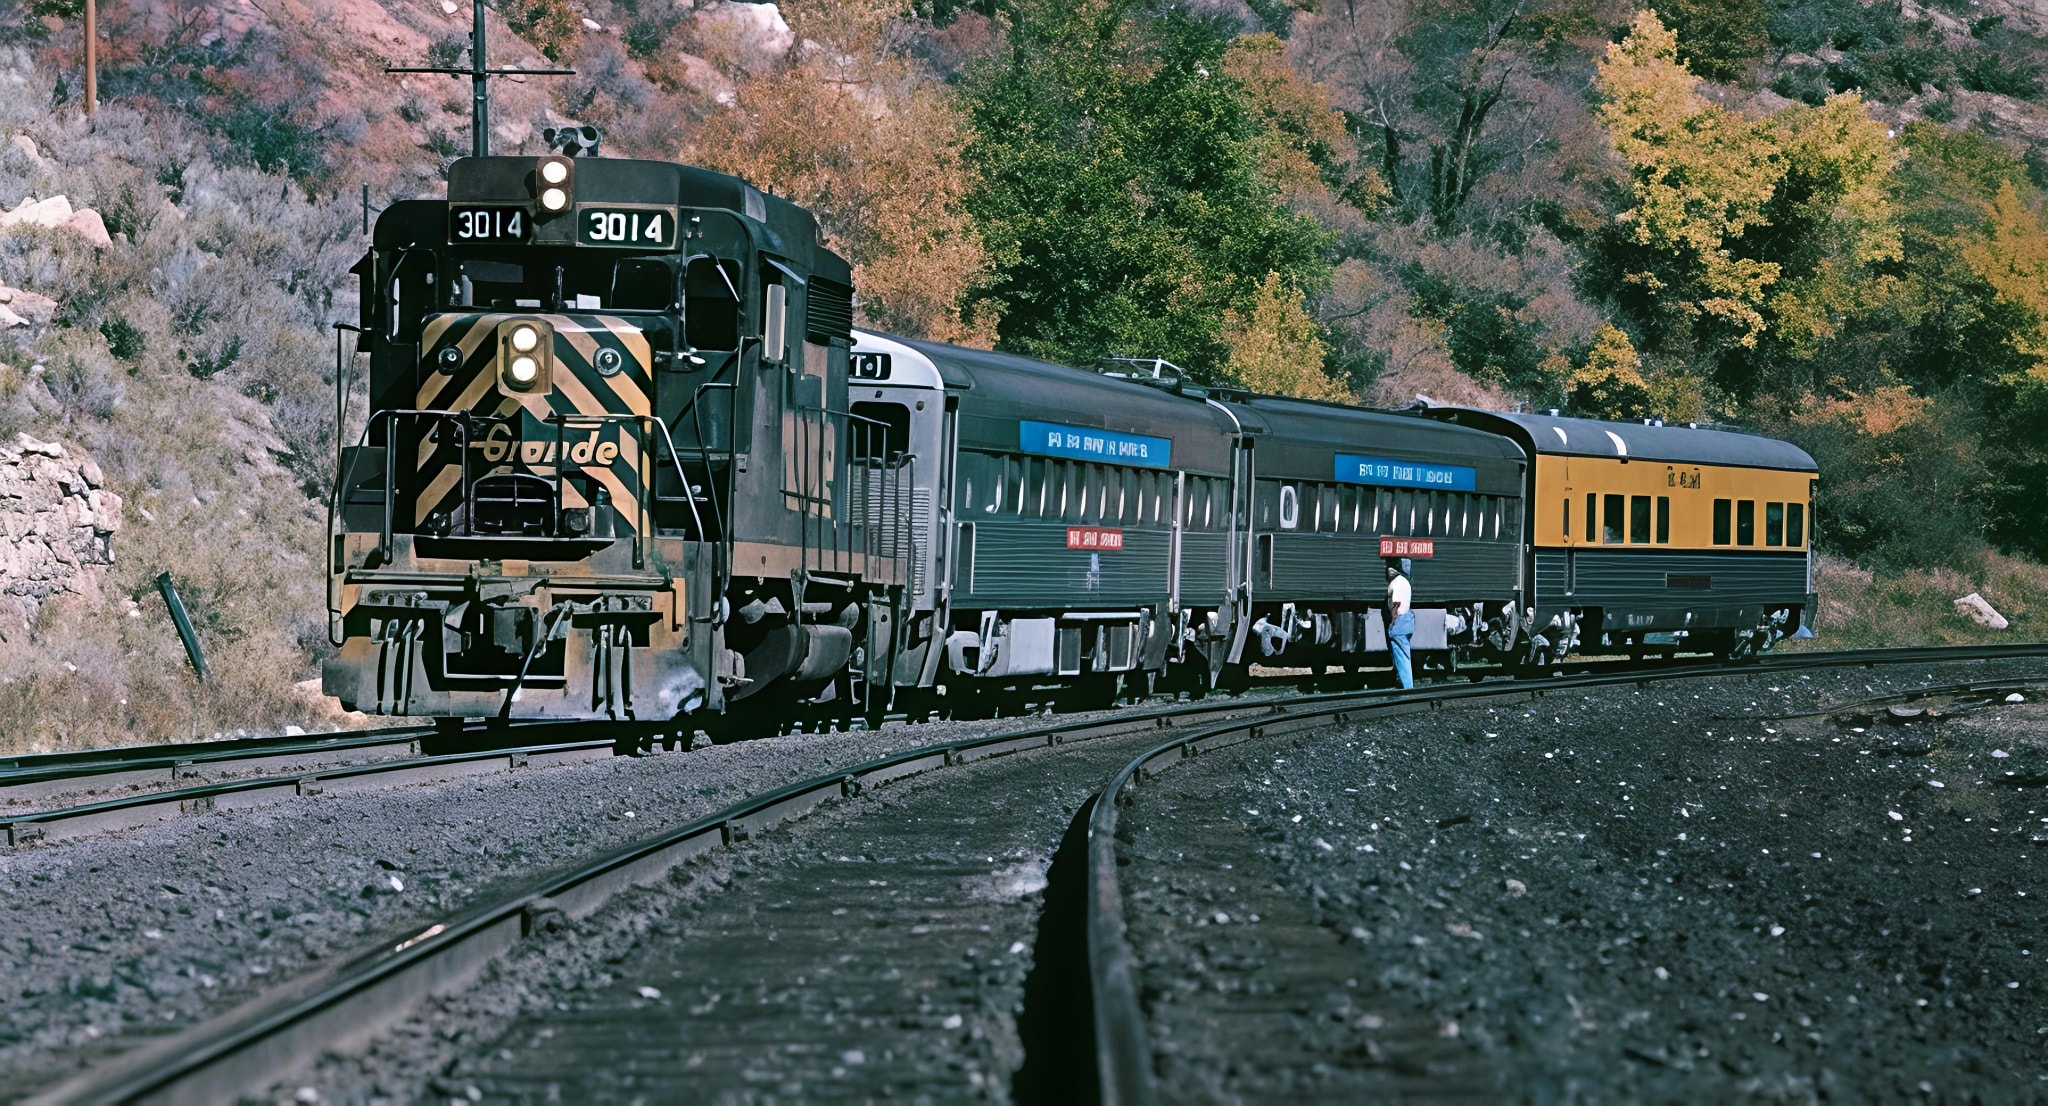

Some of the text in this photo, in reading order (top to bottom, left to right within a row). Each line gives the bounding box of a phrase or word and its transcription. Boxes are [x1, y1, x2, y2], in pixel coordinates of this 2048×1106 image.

[458, 211, 521, 238] 3014
[589, 212, 663, 243] 3014
[470, 423, 619, 465] Grande
